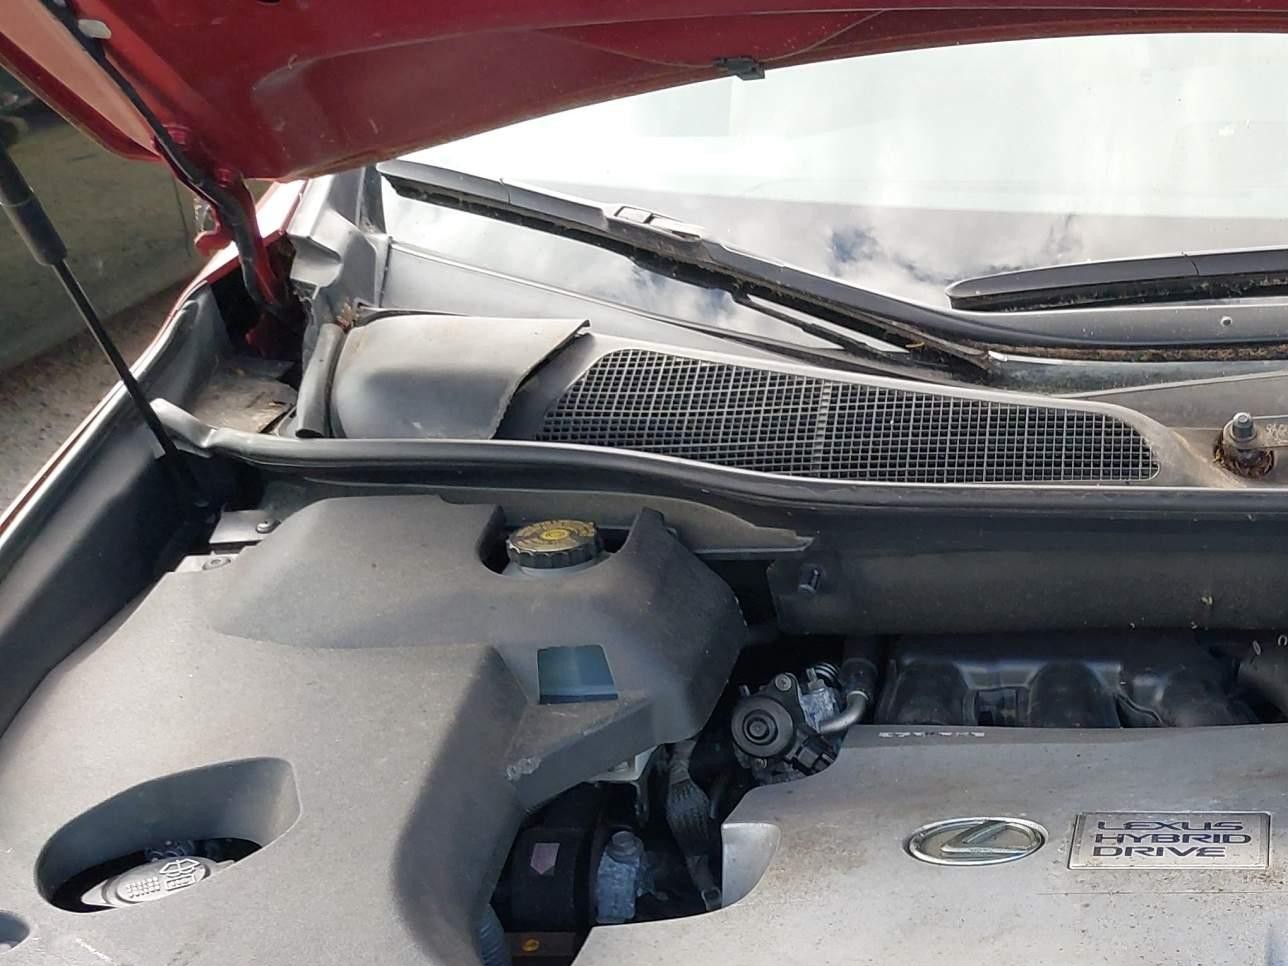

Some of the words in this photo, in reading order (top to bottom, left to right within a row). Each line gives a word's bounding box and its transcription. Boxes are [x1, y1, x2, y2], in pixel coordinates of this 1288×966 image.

[1097, 821, 1244, 831] LEXUS
[1095, 833, 1252, 844] HYBRID
[1092, 846, 1226, 857] DRIVE
